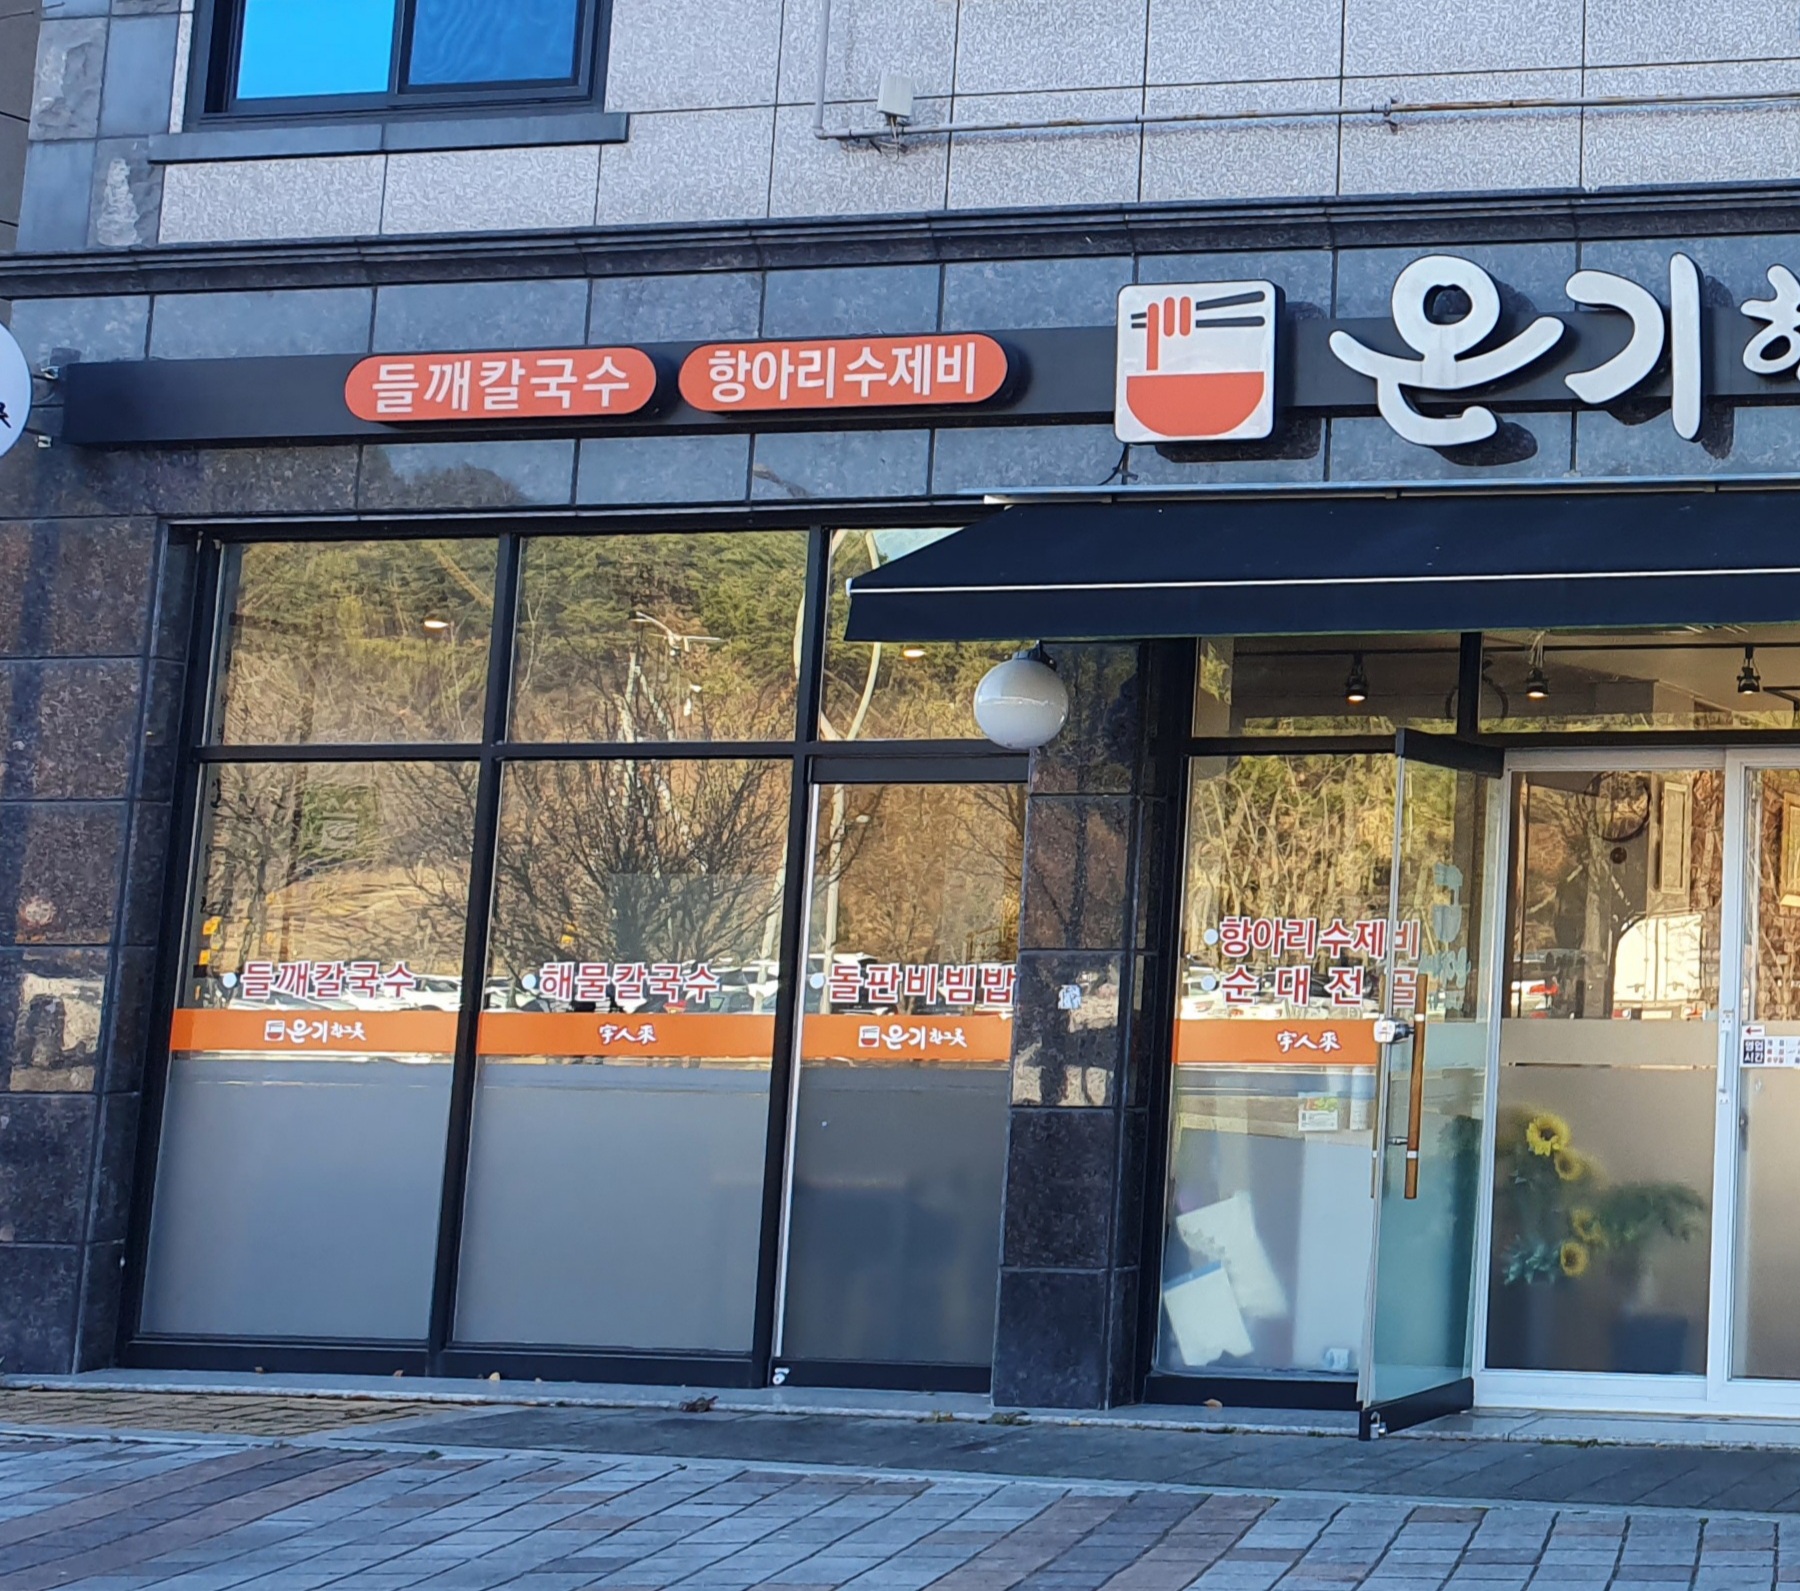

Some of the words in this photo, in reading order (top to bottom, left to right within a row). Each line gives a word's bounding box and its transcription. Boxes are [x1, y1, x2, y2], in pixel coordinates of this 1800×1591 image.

[1328, 253, 1702, 446] 온기
[371, 356, 631, 414] 들깨칼국수
[707, 341, 976, 402] 항아리수제비
[1219, 914, 1421, 960] 항아리수제비
[240, 961, 417, 1000] 들깨칼국수
[538, 962, 720, 1003] 해물칼국수
[828, 963, 1017, 1004] 돌판비빔밥
[1221, 964, 1418, 1010] 순대전골
[287, 1021, 328, 1044] 온기
[882, 1025, 926, 1050] 온기
